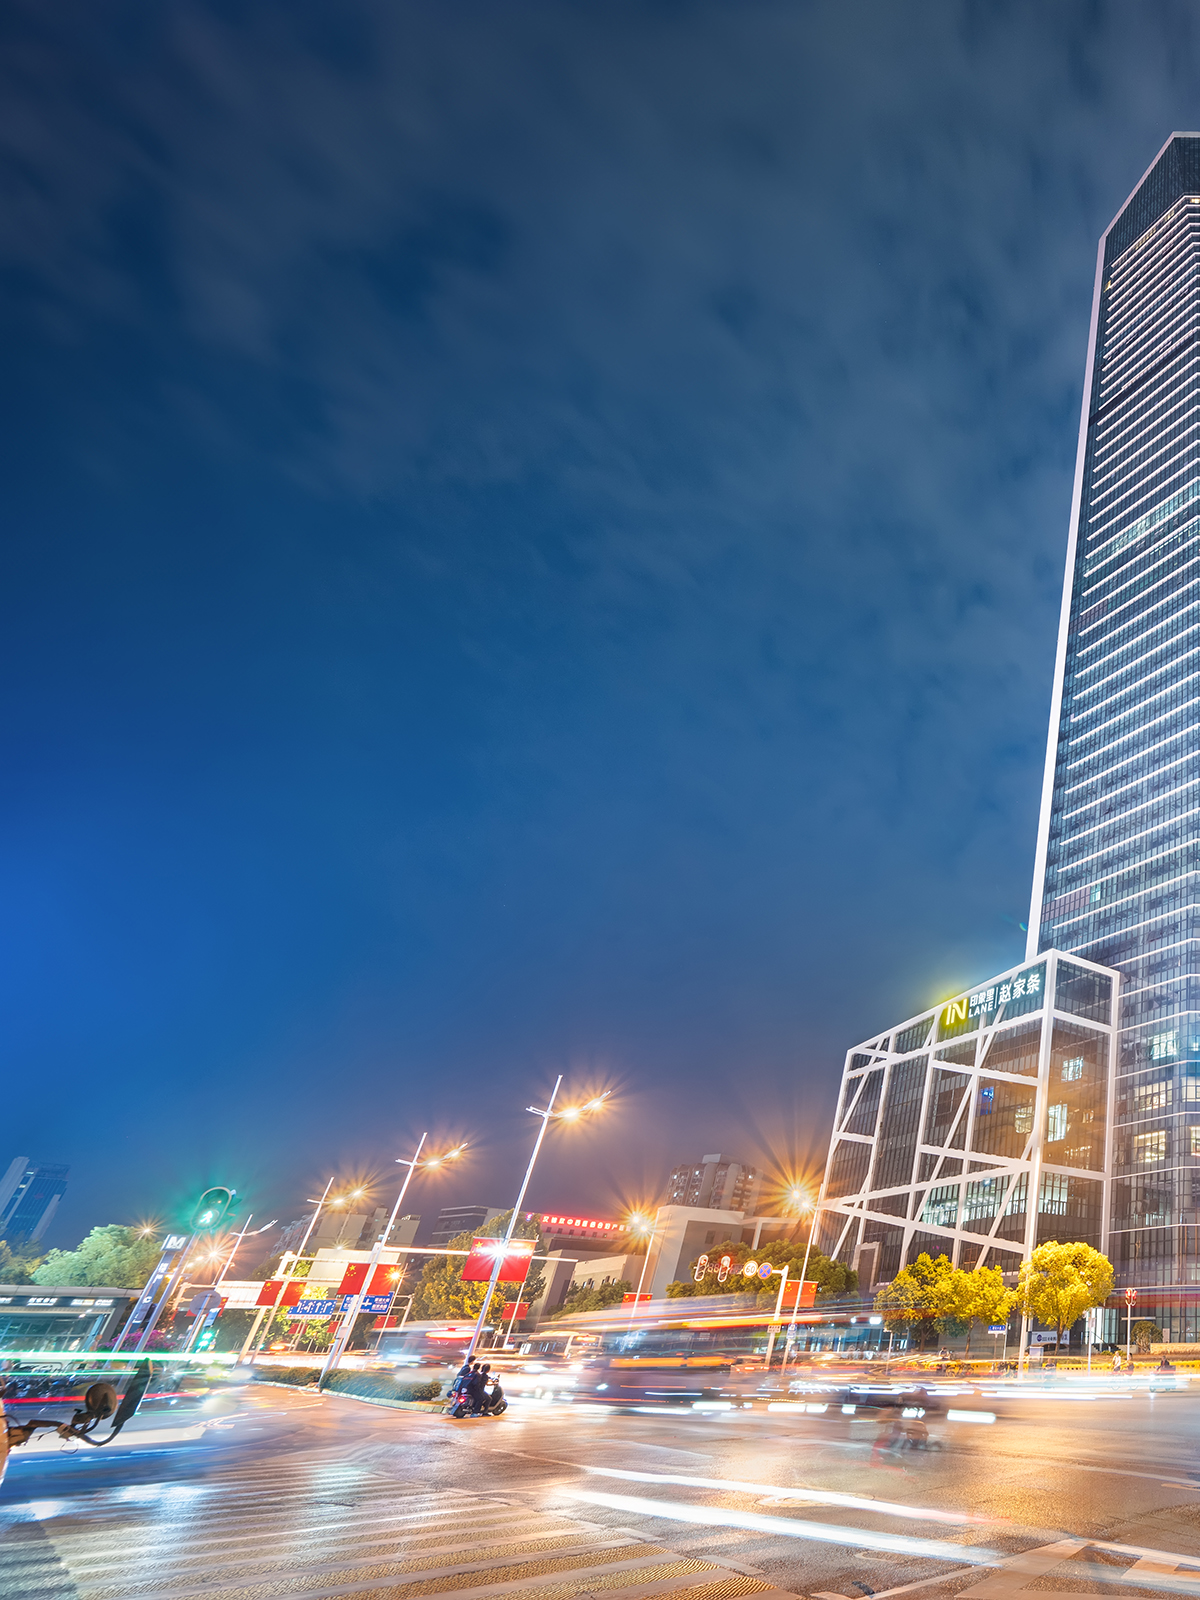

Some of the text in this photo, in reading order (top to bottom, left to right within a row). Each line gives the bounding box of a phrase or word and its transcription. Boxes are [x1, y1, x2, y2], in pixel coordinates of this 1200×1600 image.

[969, 988, 995, 1006] 印象里
[998, 974, 1040, 1004] 赵家条
[968, 1001, 994, 1018] LANE
[745, 1265, 756, 1274] 60
